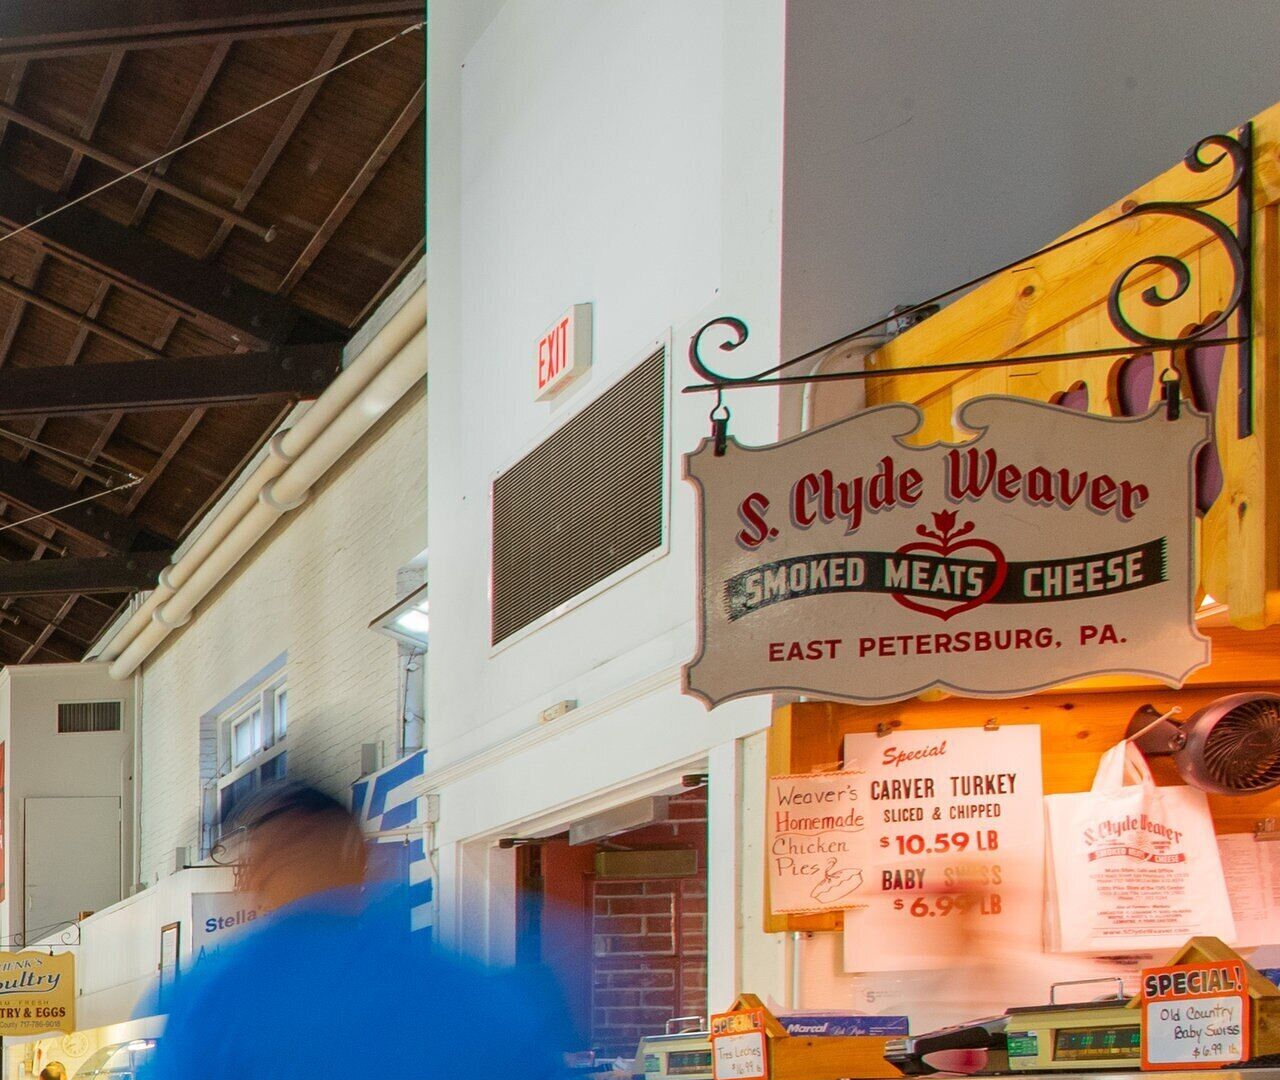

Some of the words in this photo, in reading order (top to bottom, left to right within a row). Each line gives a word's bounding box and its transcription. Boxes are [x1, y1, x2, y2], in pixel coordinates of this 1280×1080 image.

[538, 317, 569, 390] EXIT
[737, 491, 779, 548] S.
[791, 456, 924, 536] Clyde
[947, 447, 1150, 524] Weaver
[746, 556, 865, 606] SMOKED
[885, 557, 984, 598] MEATS
[1024, 551, 1144, 598] CHEESE
[769, 639, 842, 662] EAST
[859, 627, 1062, 658] PETERSBURG,
[1080, 624, 1127, 645] PA.
[882, 740, 948, 767] Special
[777, 785, 859, 807] Weaver's
[871, 778, 935, 801] CARVER
[950, 773, 1017, 797] TURKEY
[776, 807, 864, 833] Homemade
[884, 806, 924, 823] SLICED
[932, 806, 942, 820] &
[949, 803, 1001, 819] CHIPPED
[772, 837, 849, 856] Chicken
[977, 830, 999, 851] LB
[776, 857, 820, 877] Pies
[882, 868, 926, 891] BABY
[980, 894, 1002, 915] LB
[1144, 966, 1243, 999] SPECIAL!
[24, 1008, 32, 1018] &
[36, 1007, 66, 1017] EGGS
[1160, 1006, 1180, 1021] Old
[1186, 1003, 1235, 1023] Country
[787, 1022, 829, 1033] Marcal
[1174, 1026, 1204, 1043] Baby
[1204, 1023, 1240, 1037] Swiss
